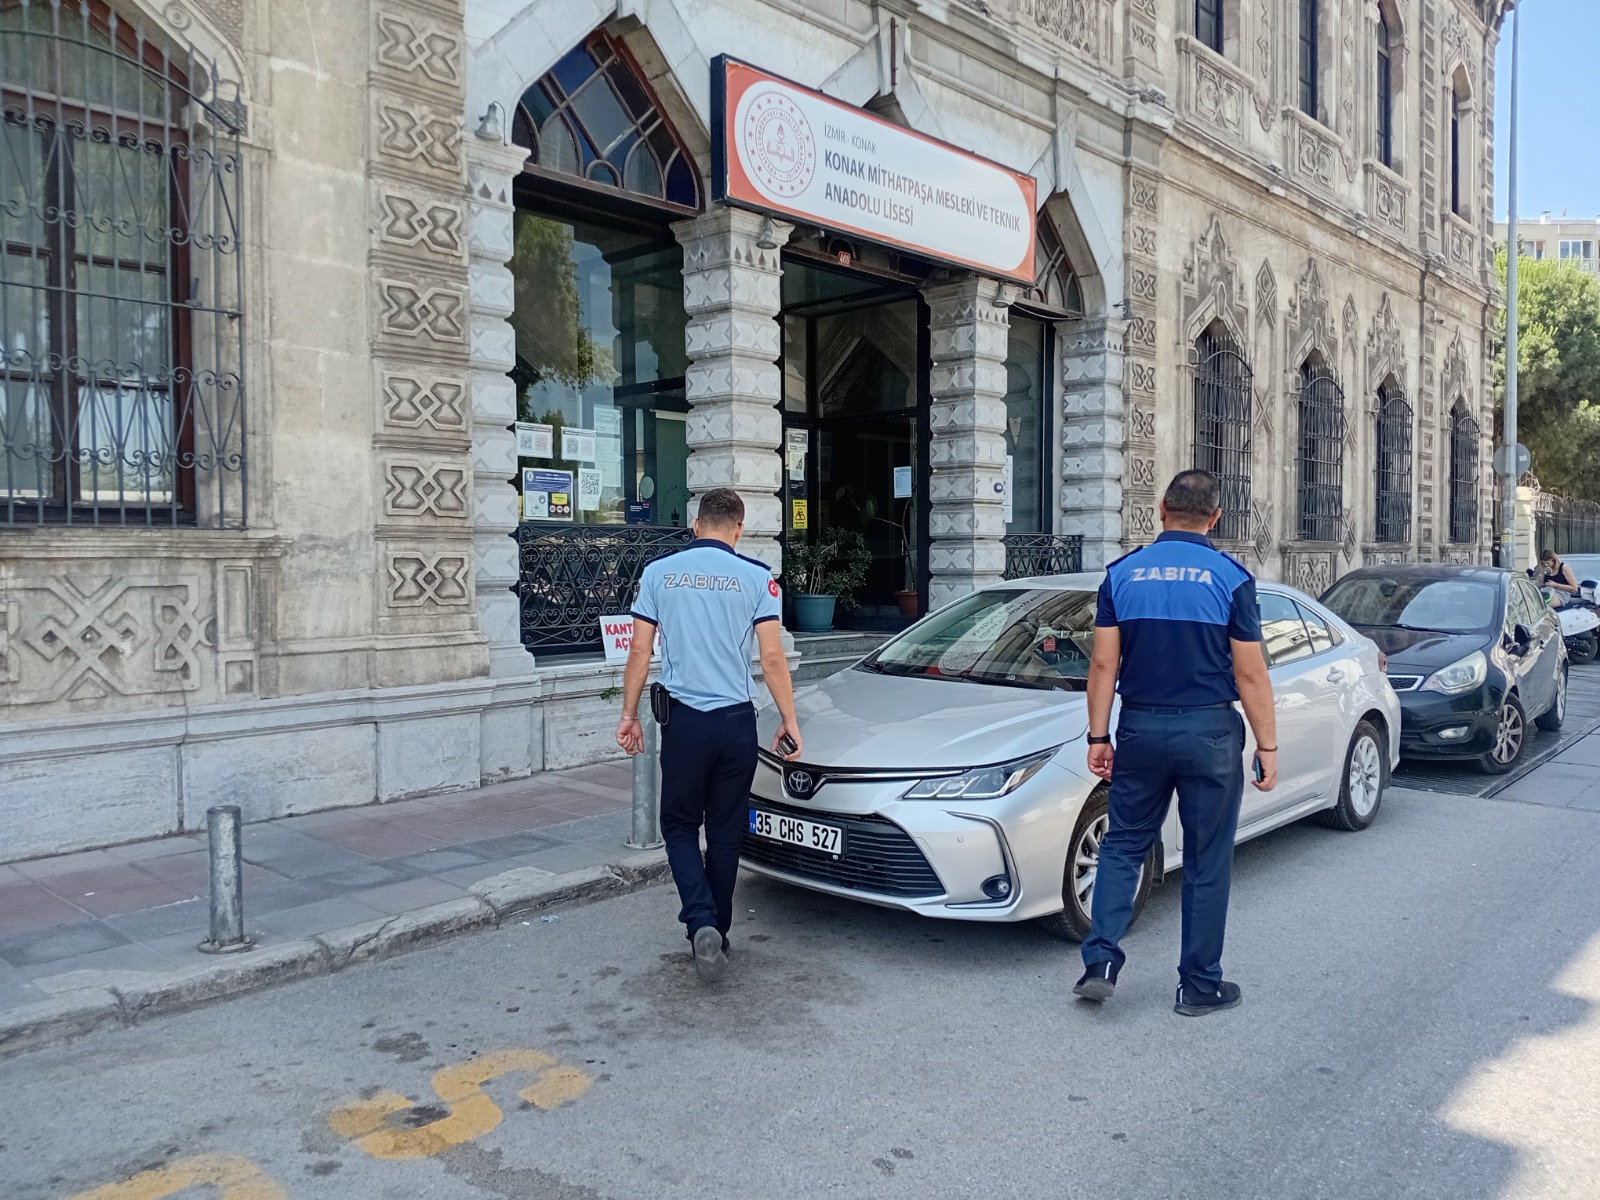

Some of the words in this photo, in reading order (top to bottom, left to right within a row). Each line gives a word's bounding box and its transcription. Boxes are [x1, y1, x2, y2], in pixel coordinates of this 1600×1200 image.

[824, 121, 846, 144] İZMİR
[851, 134, 877, 155] KONAK
[824, 148, 865, 181] KONAK
[867, 163, 934, 206] MİTHATPAŞA
[935, 188, 975, 217] MESLEKİ
[976, 202, 988, 222] VE
[989, 206, 1020, 233] TEKNİK
[824, 182, 881, 216] ANADOLU
[883, 198, 914, 227] LİSESİ
[663, 573, 742, 593] ZABITA
[1131, 566, 1213, 586] ZABITA
[605, 623, 633, 635] KANT
[756, 813, 772, 835] 35
[779, 818, 804, 843] CHS
[812, 825, 839, 851] 527
